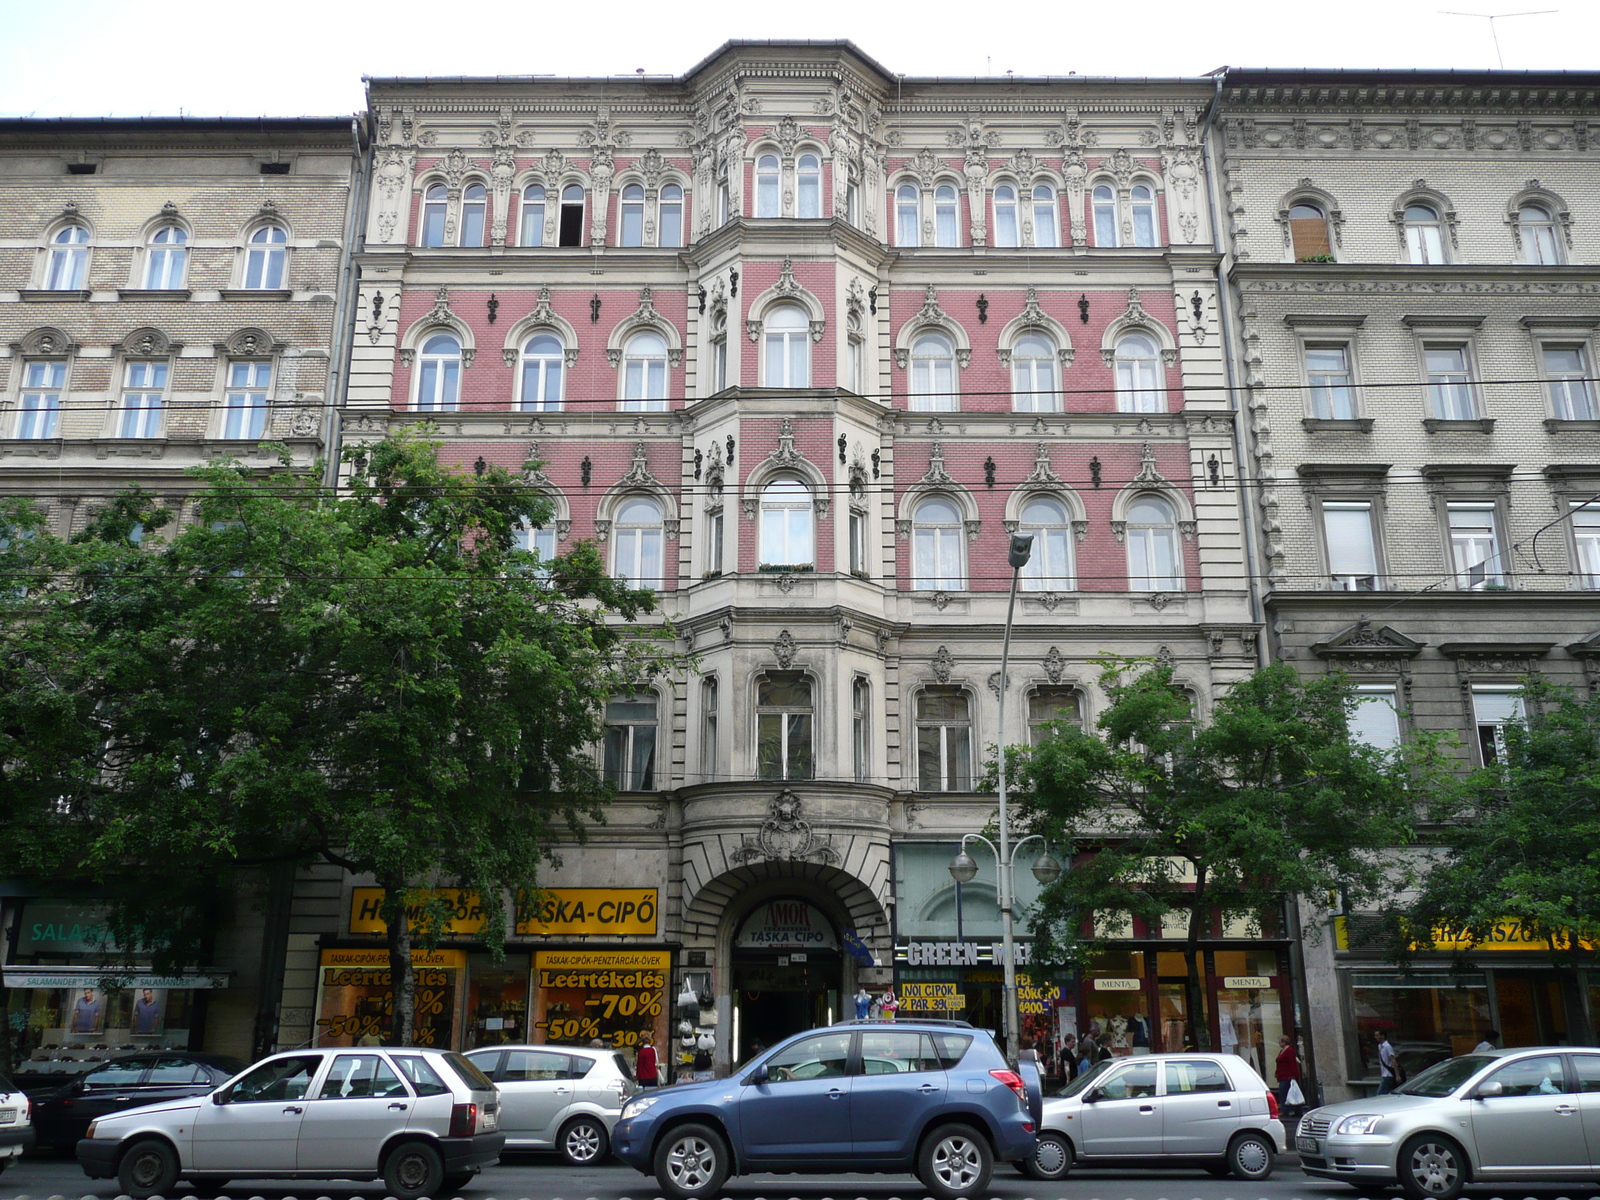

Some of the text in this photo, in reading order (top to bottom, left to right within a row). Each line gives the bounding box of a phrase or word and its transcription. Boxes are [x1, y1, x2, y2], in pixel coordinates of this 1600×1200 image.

[765, 903, 811, 926] AMOR
[908, 942, 978, 966] GREEN
[323, 968, 449, 986] Leértéelés
[540, 971, 665, 989] Leértékelés
[584, 991, 663, 1019] -70%
[900, 998, 907, 1009] 2
[317, 1015, 381, 1037] -50%
[535, 1018, 601, 1040] -50%
